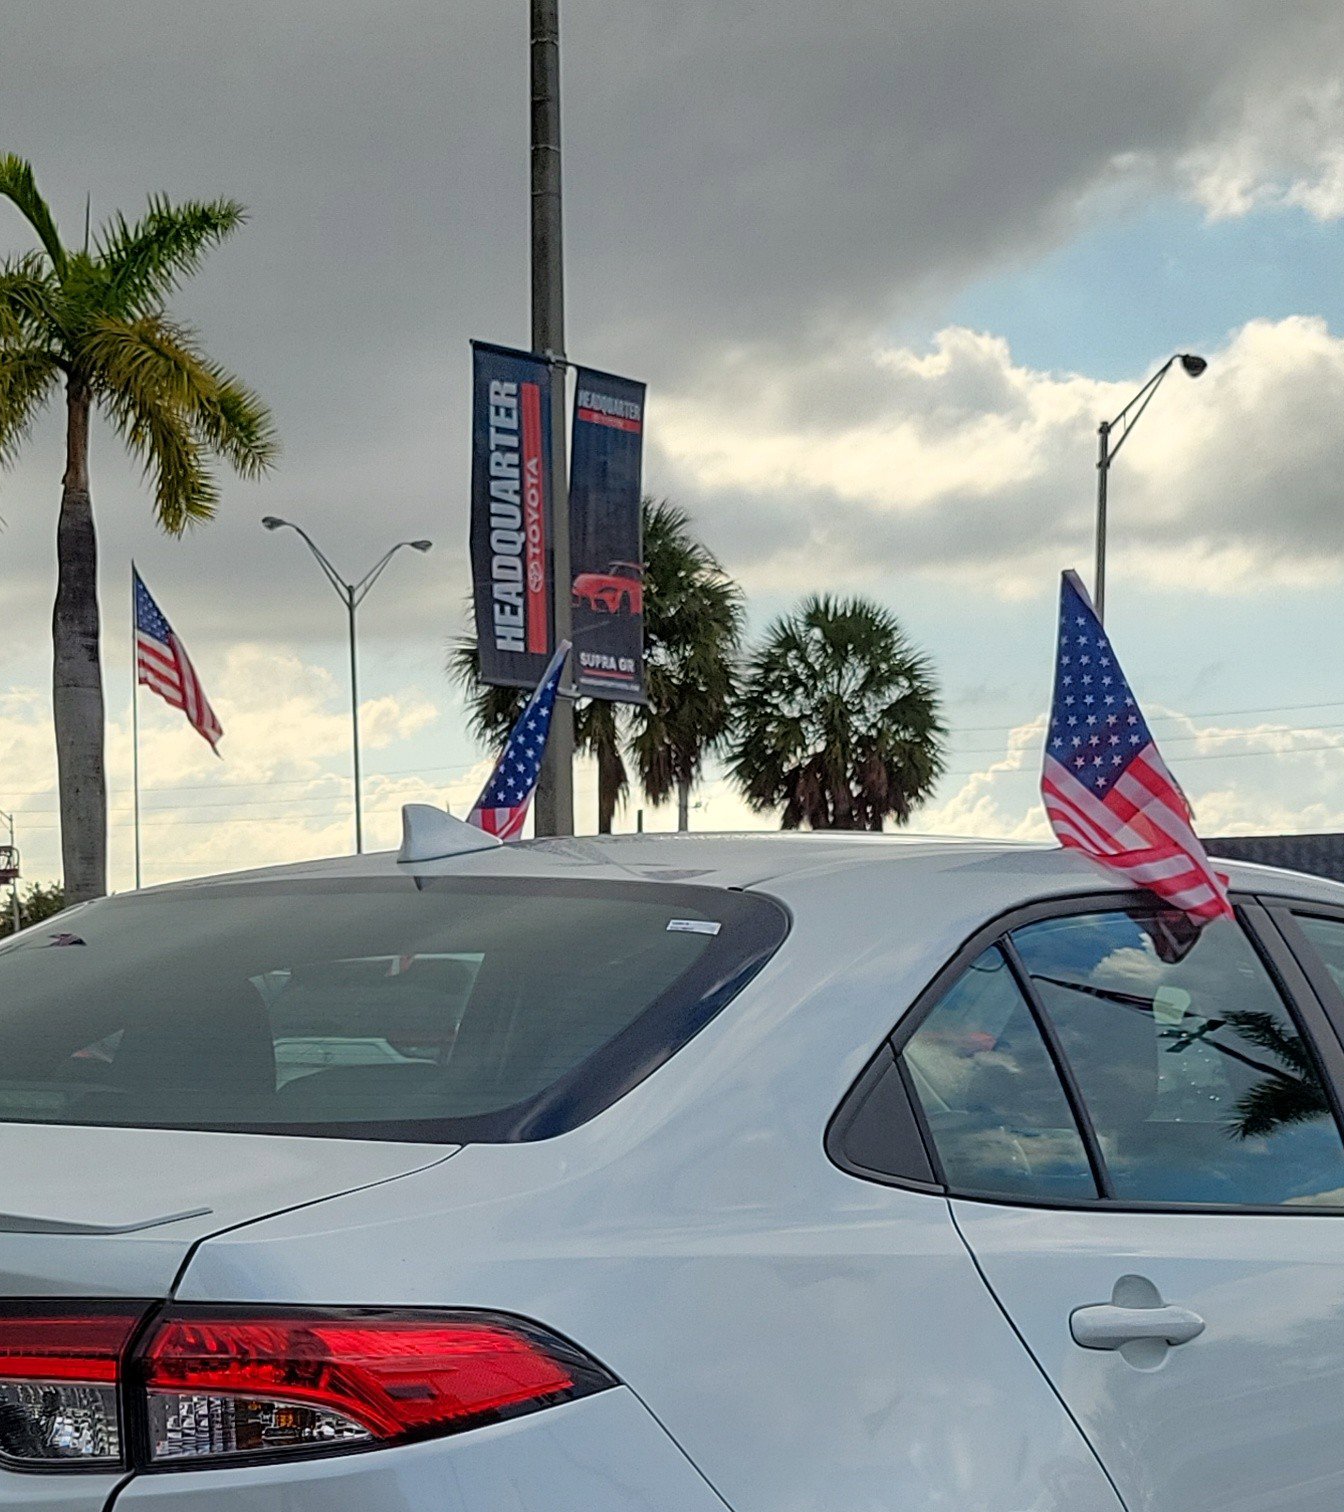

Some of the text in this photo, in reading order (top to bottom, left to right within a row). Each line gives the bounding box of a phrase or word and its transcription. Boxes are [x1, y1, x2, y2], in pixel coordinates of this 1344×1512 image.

[488, 379, 525, 652] HEADQUARTER
[524, 457, 542, 561] TOYOTA
[580, 652, 635, 674] SUPRA GR
